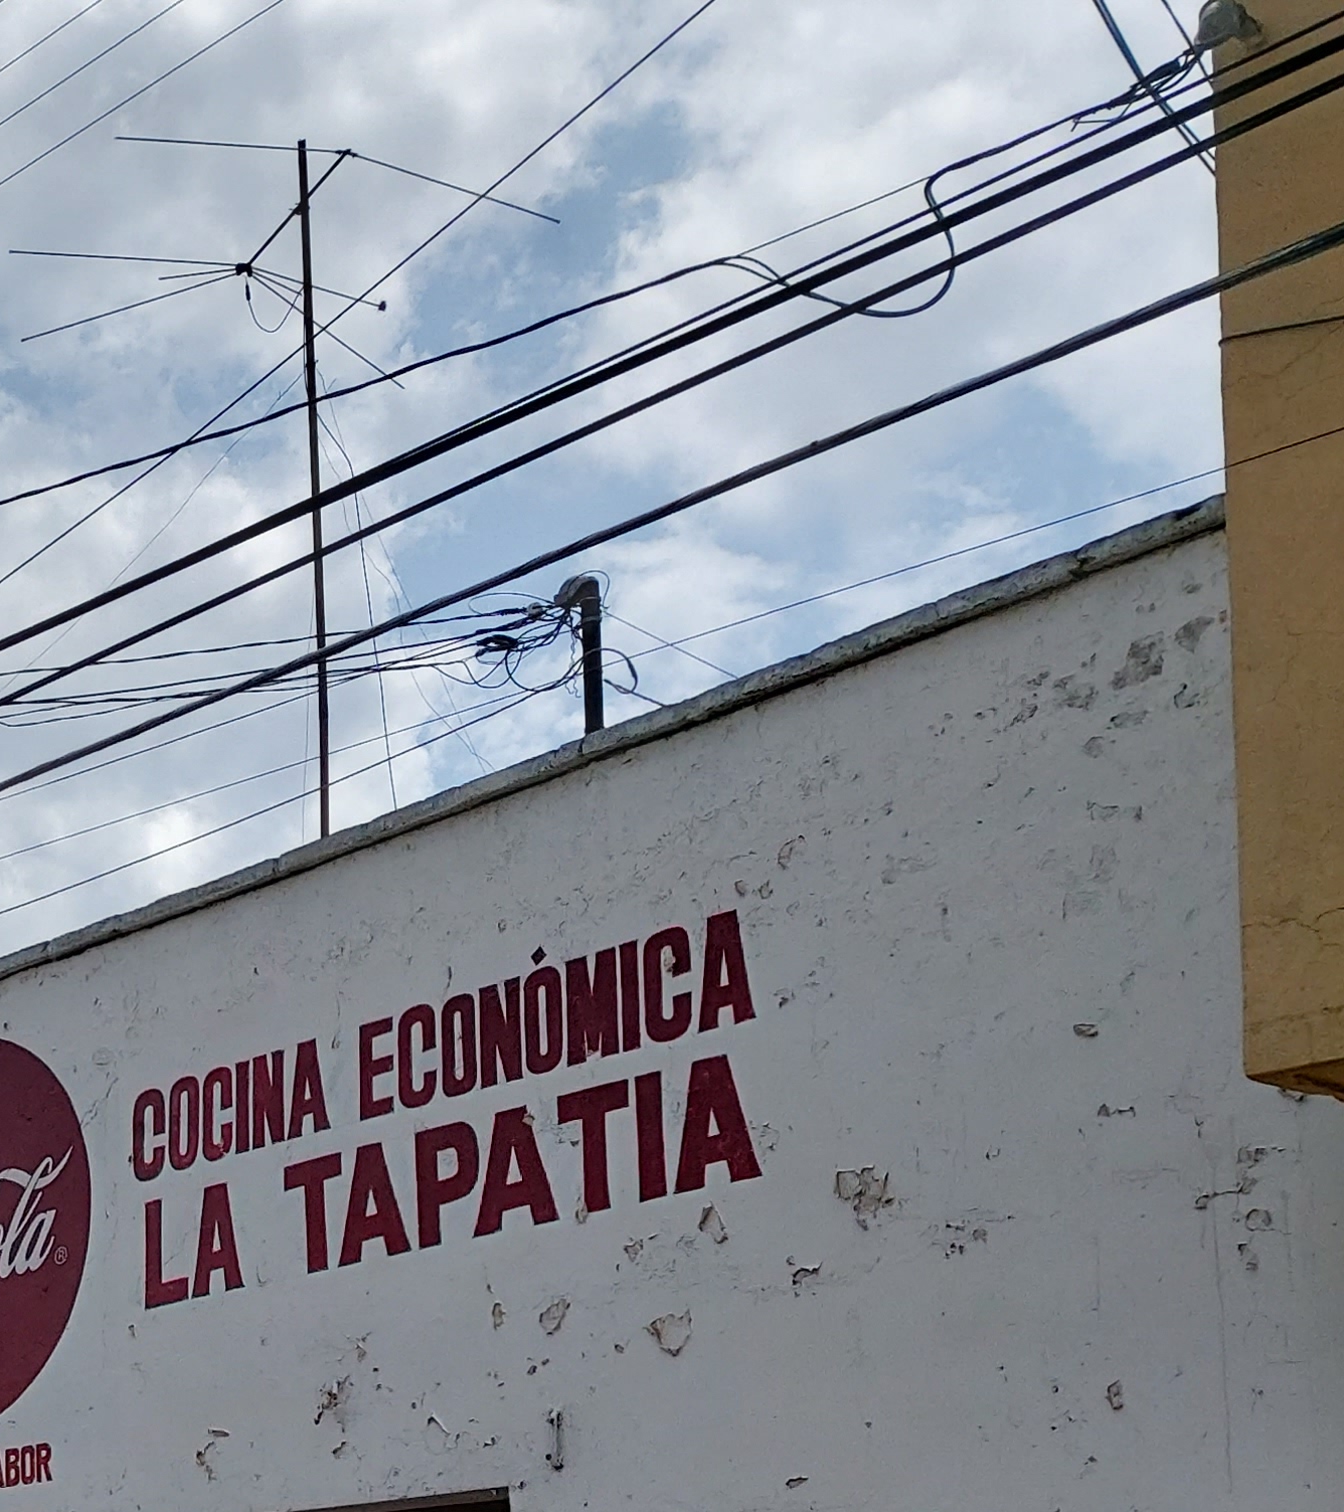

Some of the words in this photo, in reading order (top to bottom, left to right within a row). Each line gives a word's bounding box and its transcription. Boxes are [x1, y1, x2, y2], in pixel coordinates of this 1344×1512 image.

[130, 1037, 331, 1182] COCINA
[144, 1183, 245, 1310] LA
[283, 1054, 763, 1275] TAPATIA
